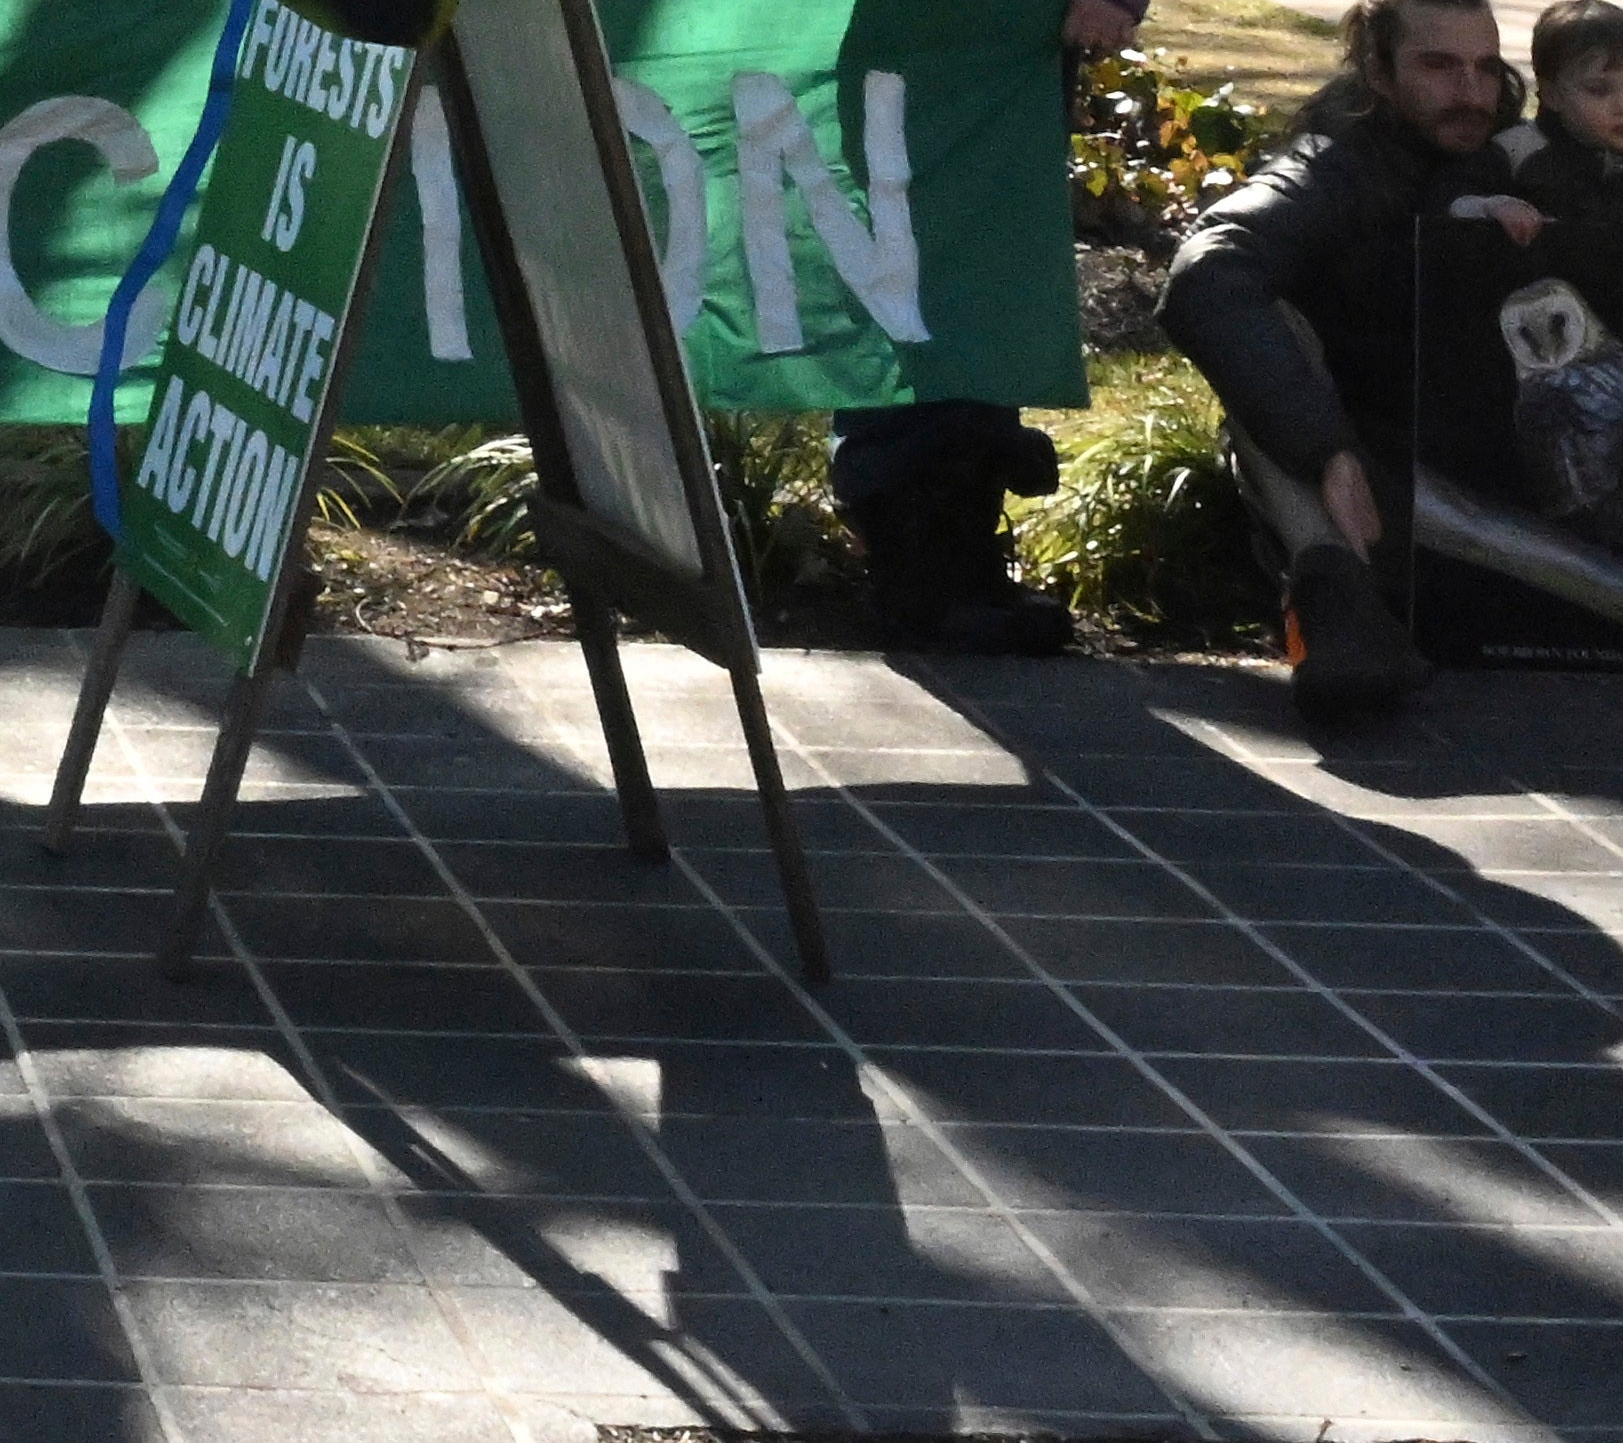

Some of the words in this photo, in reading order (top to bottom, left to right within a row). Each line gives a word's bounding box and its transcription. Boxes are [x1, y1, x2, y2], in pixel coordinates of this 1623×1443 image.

[260, 134, 317, 253] IS
[176, 243, 337, 424] CLIMATE
[135, 373, 300, 583] ACTION
